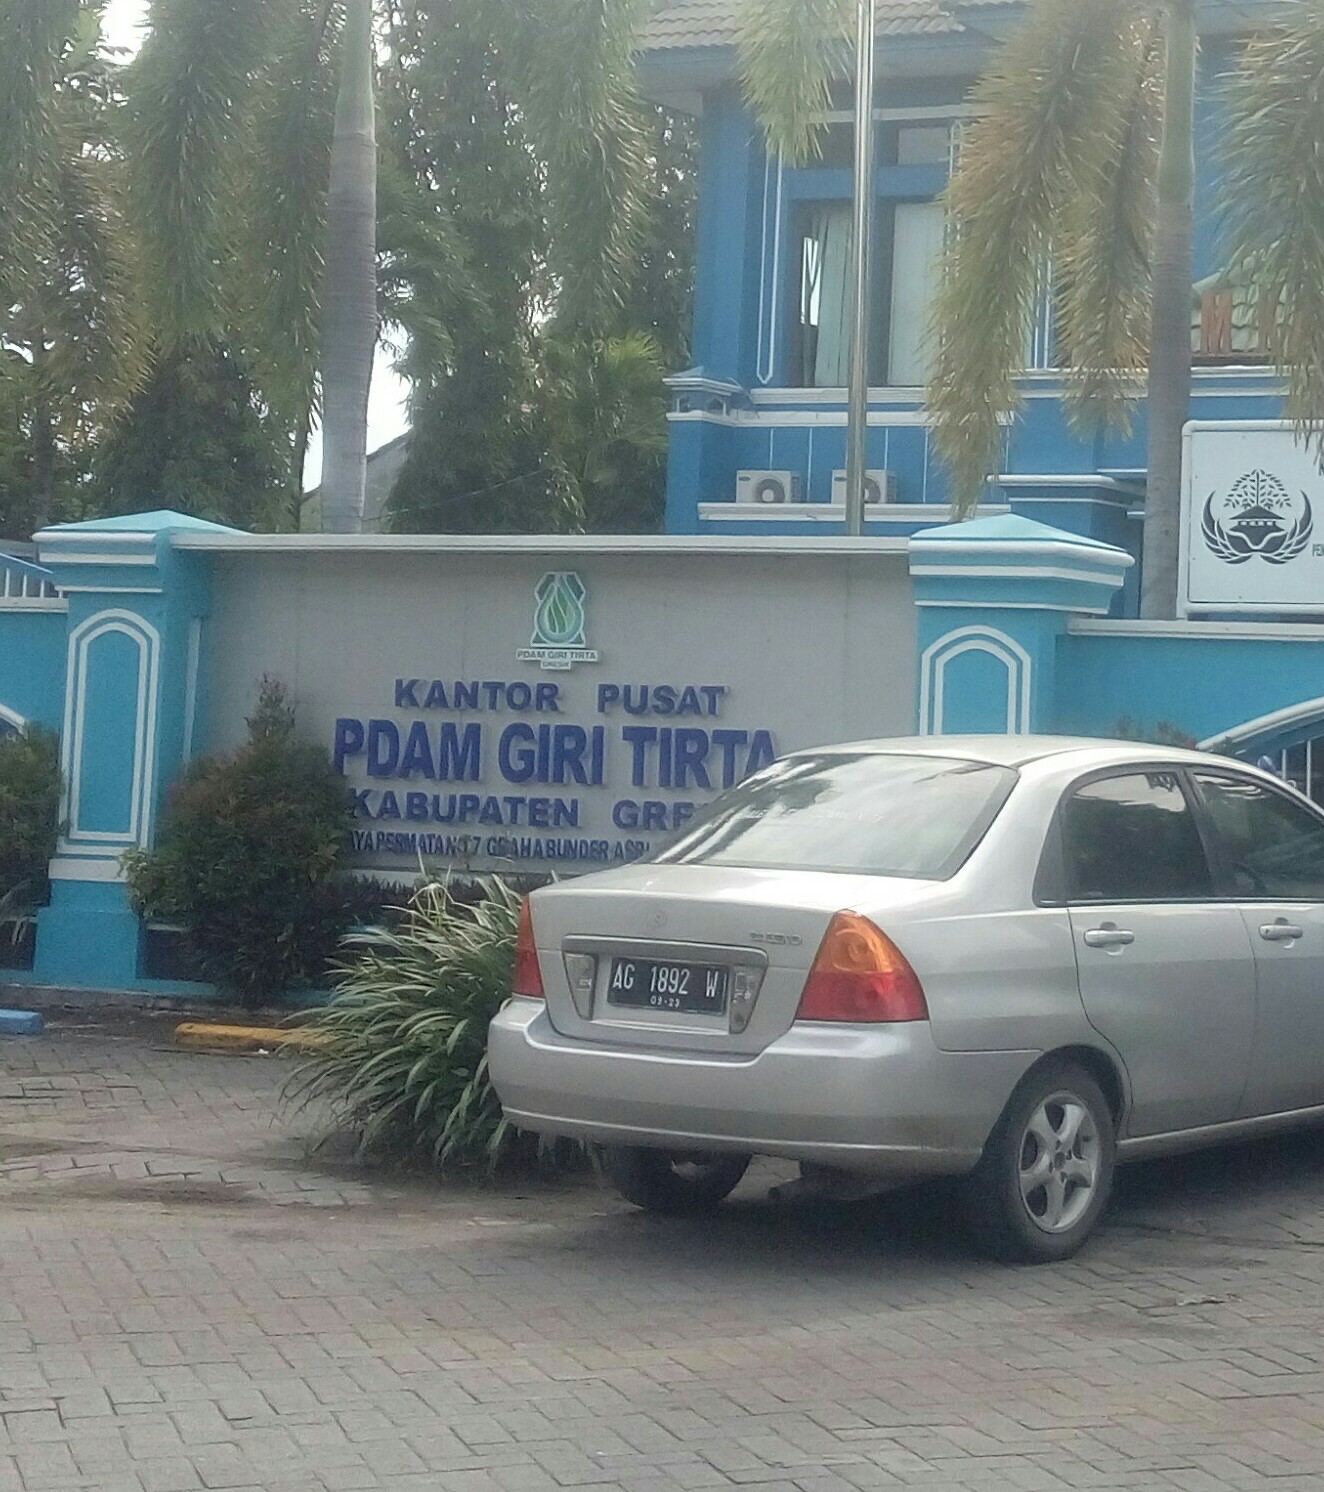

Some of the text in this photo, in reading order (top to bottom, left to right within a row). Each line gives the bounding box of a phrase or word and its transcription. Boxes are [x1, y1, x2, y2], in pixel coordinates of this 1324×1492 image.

[395, 678, 725, 716] KANTOR PUSAT
[335, 718, 775, 790] PDAM GIRI TIRTA
[348, 787, 579, 827] KABUPATEN
[612, 963, 719, 998] AG 1892 W
